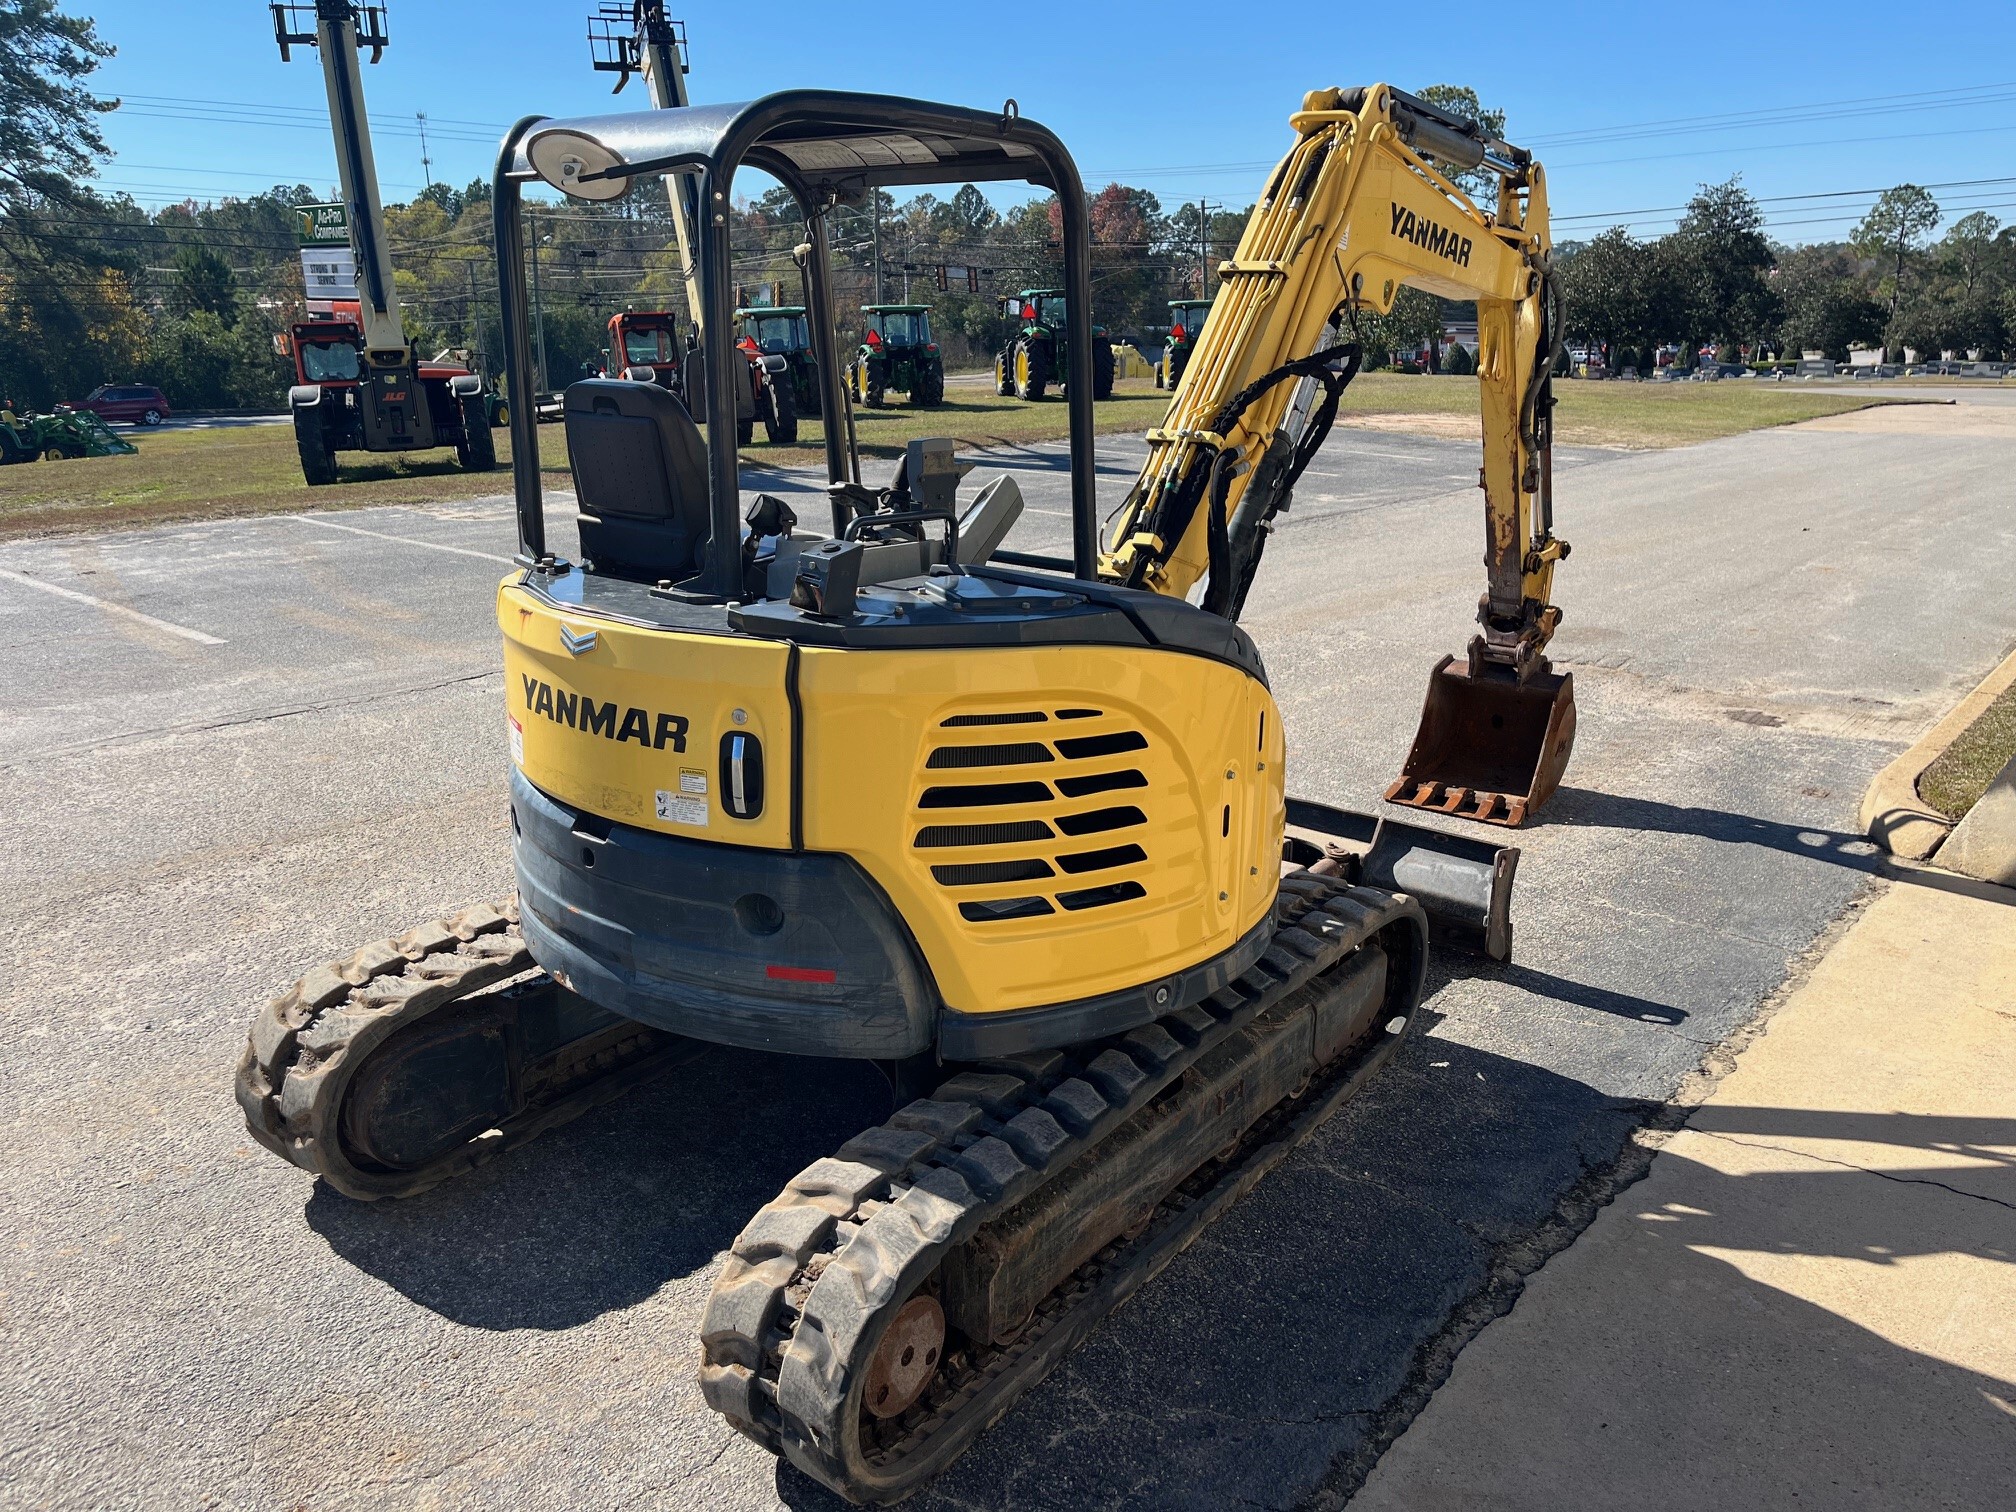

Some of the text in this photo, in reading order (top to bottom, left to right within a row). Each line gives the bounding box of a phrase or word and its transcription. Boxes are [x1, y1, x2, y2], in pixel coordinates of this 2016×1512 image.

[1391, 202, 1472, 268] YANMAR
[310, 264, 328, 273] STRONG
[317, 276, 336, 285] SERVICE
[382, 391, 406, 401] JLG
[522, 673, 689, 753] YANMAR
